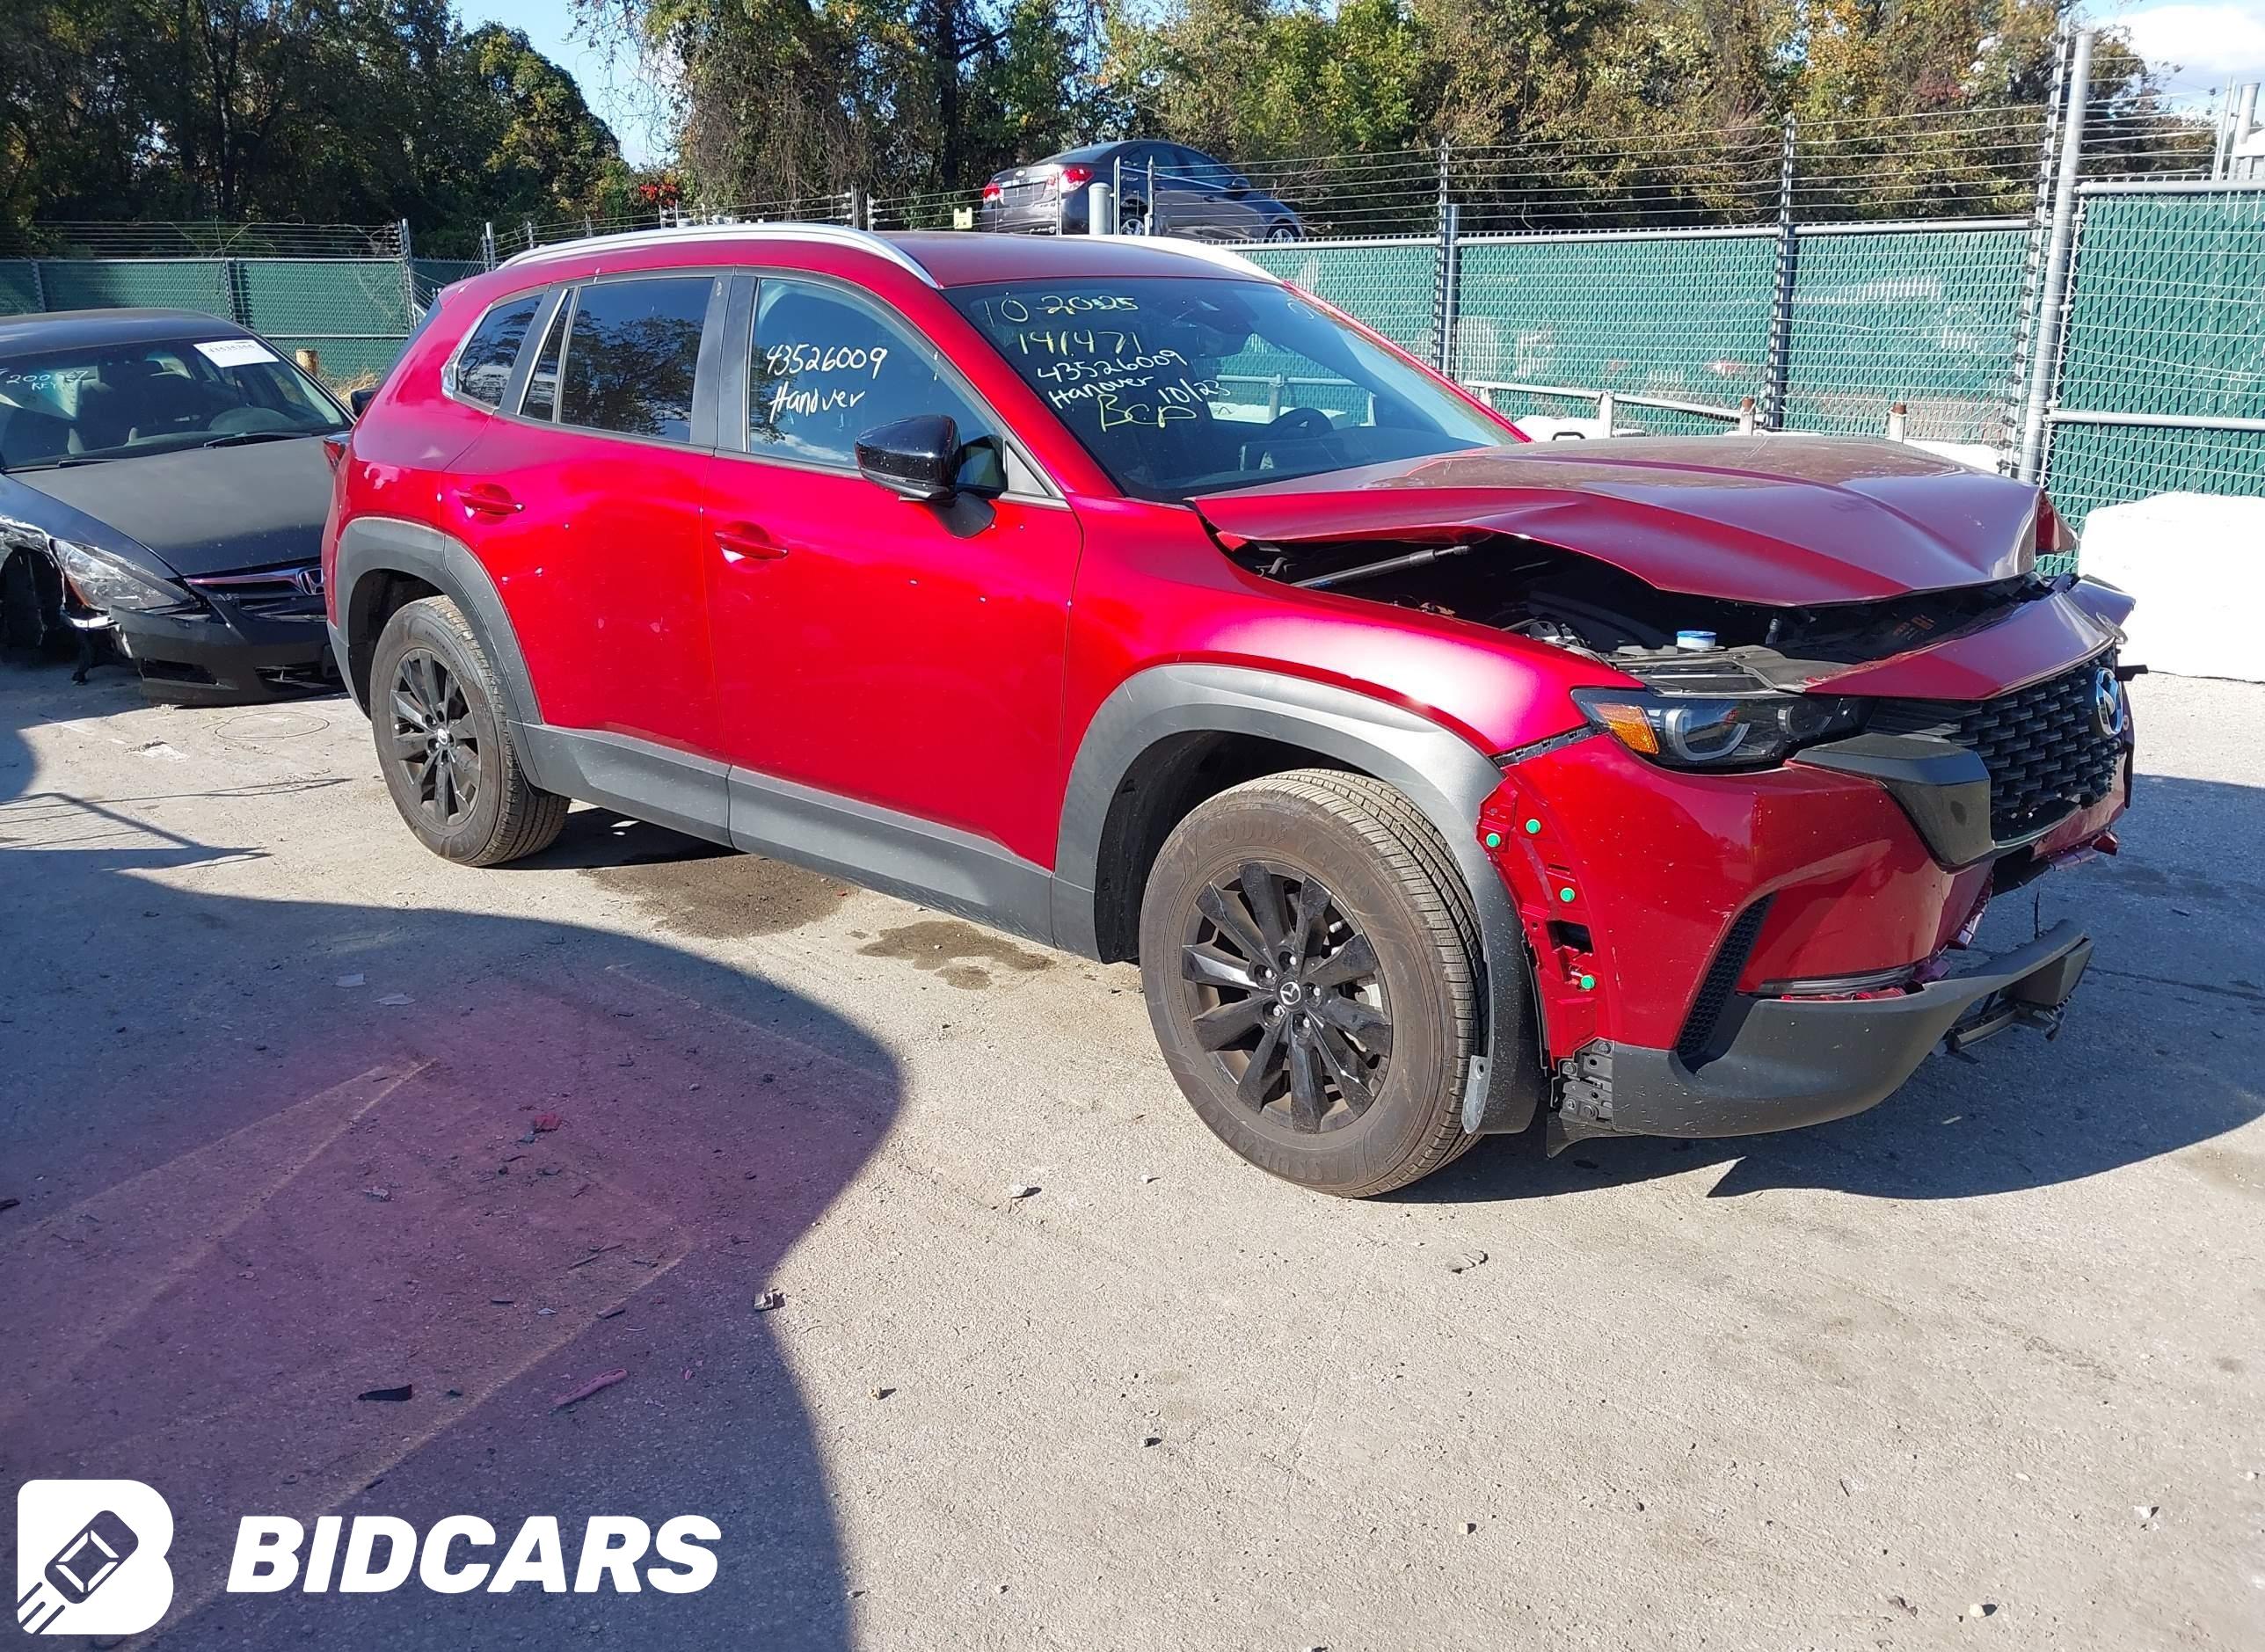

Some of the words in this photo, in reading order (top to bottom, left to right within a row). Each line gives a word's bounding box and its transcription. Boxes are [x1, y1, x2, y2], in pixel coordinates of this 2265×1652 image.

[767, 344, 888, 380] 43526009
[1038, 350, 1187, 382] 43526009
[768, 381, 866, 424] Hanover
[1048, 376, 1154, 410] Hanover
